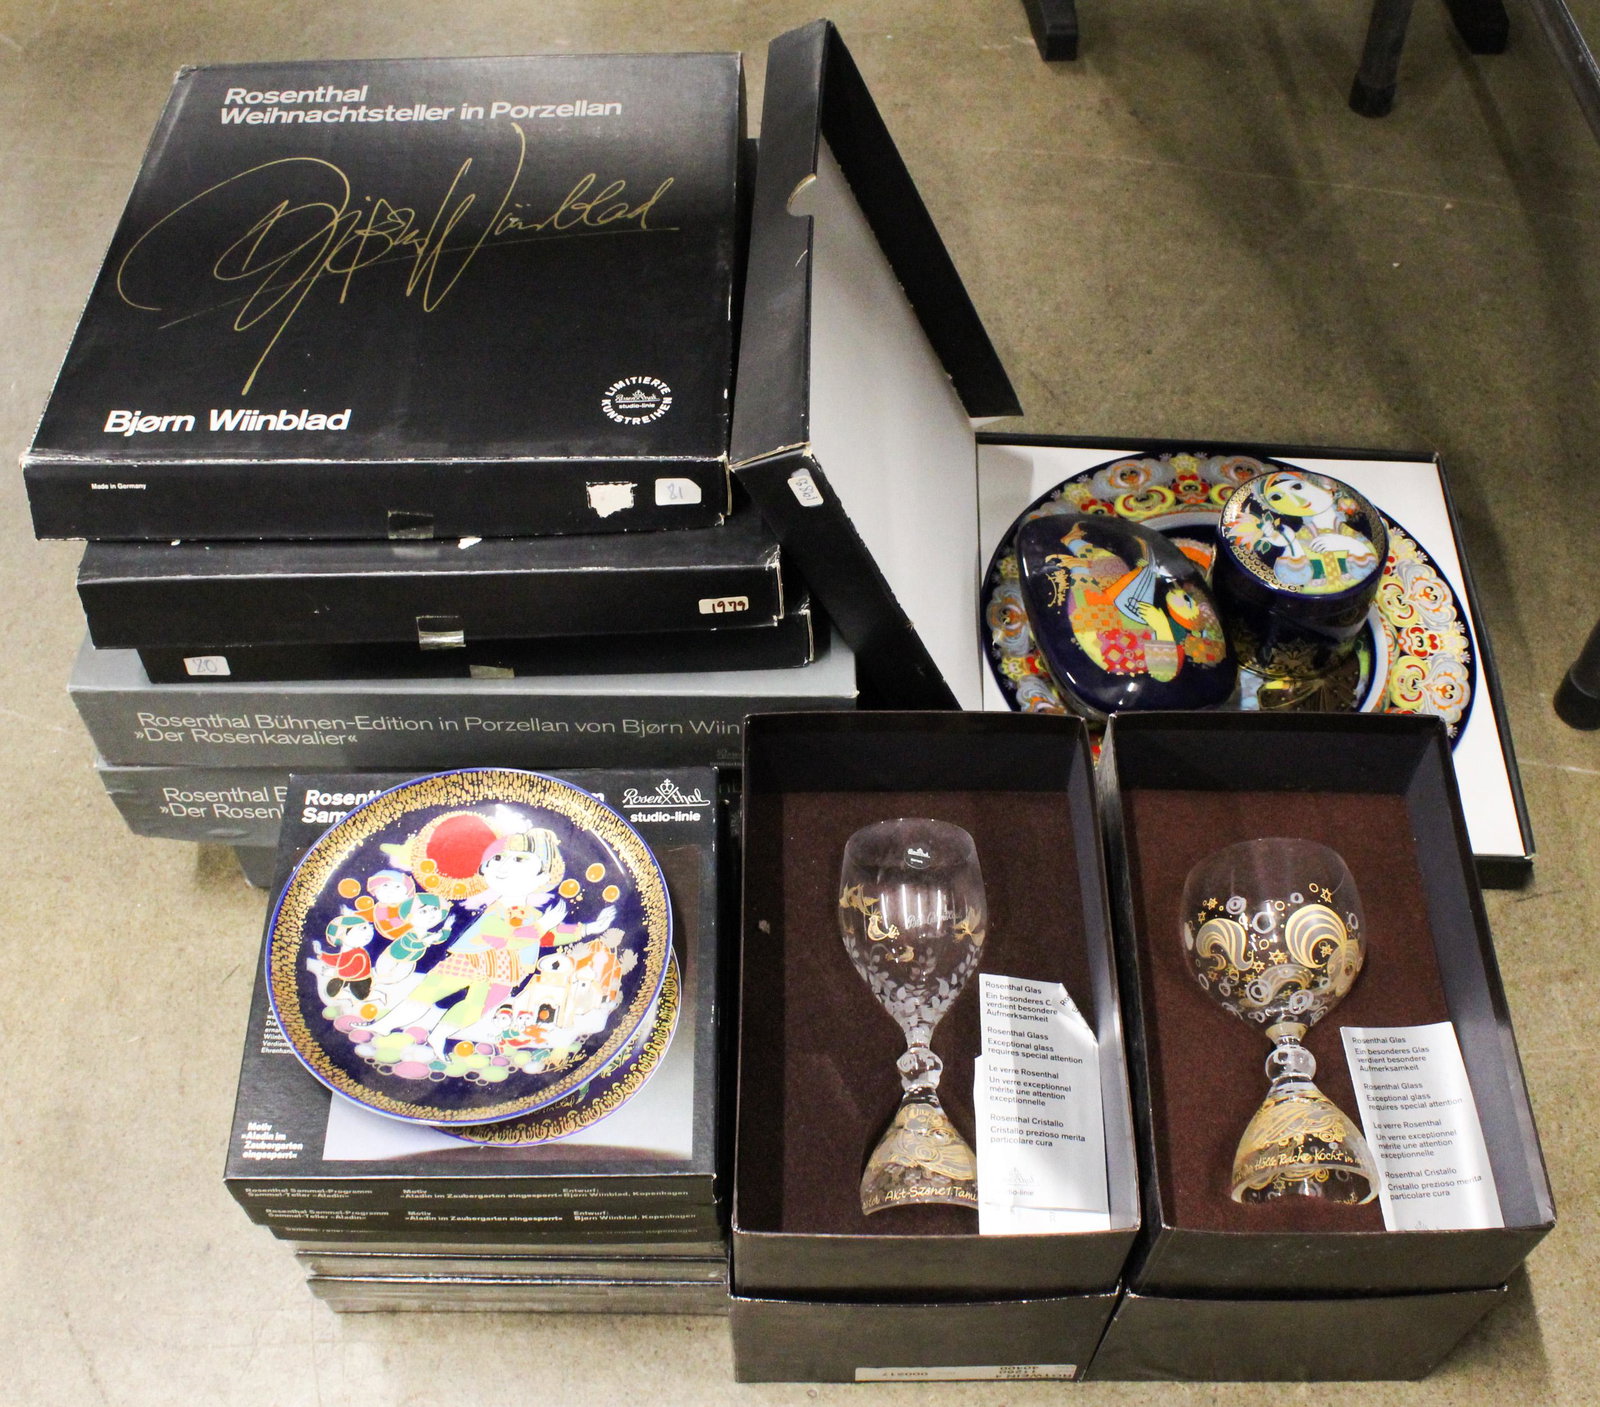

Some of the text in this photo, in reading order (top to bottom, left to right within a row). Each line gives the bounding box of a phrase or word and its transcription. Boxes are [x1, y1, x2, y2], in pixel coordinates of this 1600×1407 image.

[224, 85, 368, 104] Rosenthal
[221, 100, 622, 124] Weihnachtsteller in Porzellan
[605, 376, 671, 396] LIMITIERTE
[601, 396, 672, 425] KUNSTREIHEN
[104, 409, 352, 436] Bjørn Wiinblad
[712, 600, 746, 613] 1979
[137, 712, 250, 728] Rosenthal
[256, 714, 433, 731] Bühnen-Edition
[439, 716, 458, 731] in
[464, 716, 568, 732] Porzellan
[575, 720, 615, 734] von
[622, 719, 682, 738] Bjørn
[192, 728, 358, 745] Rosenkavalier«
[163, 787, 268, 802] Rosenthal
[622, 782, 710, 808] Rosenthal
[630, 812, 700, 823] studio-linie
[986, 981, 1042, 994] Rosenthal Glas
[1000, 993, 1043, 1006] besonderes
[987, 1002, 1058, 1015] verdient besondere
[987, 1009, 1048, 1022] Aufmerksamkeit
[988, 1026, 1048, 1040] Rosenthal Glass
[988, 1038, 1054, 1052] Exceptional glass
[988, 1048, 1083, 1064] requires special attention
[1021, 1068, 1058, 1079] Rosenthal
[1359, 1064, 1418, 1072] Aufmerksamkeit
[1023, 1080, 1071, 1092] exceptionnel
[990, 1095, 1045, 1106] exceptionnelle
[1032, 1090, 1065, 1100] attention
[1366, 1094, 1408, 1102] Exceptional
[1369, 1098, 1462, 1112] requires special attention
[247, 1122, 272, 1131] Motiv
[991, 1114, 1064, 1128] Rosenthal Cristallo
[1403, 1120, 1442, 1128] Rosenthal
[991, 1126, 1024, 1135] Cristallo
[1026, 1130, 1059, 1138] prezioso
[1408, 1130, 1456, 1140] exceptionnel
[244, 1140, 304, 1152] Zaubergarten
[991, 1136, 1033, 1145] particolare
[1419, 1139, 1453, 1148] attention
[1381, 1150, 1434, 1159] exceptionnelle
[1385, 1168, 1456, 1179] Rosenthal Cristallo
[1388, 1175, 1482, 1191] Cristallo prezioso merita
[1390, 1191, 1430, 1200] particolare
